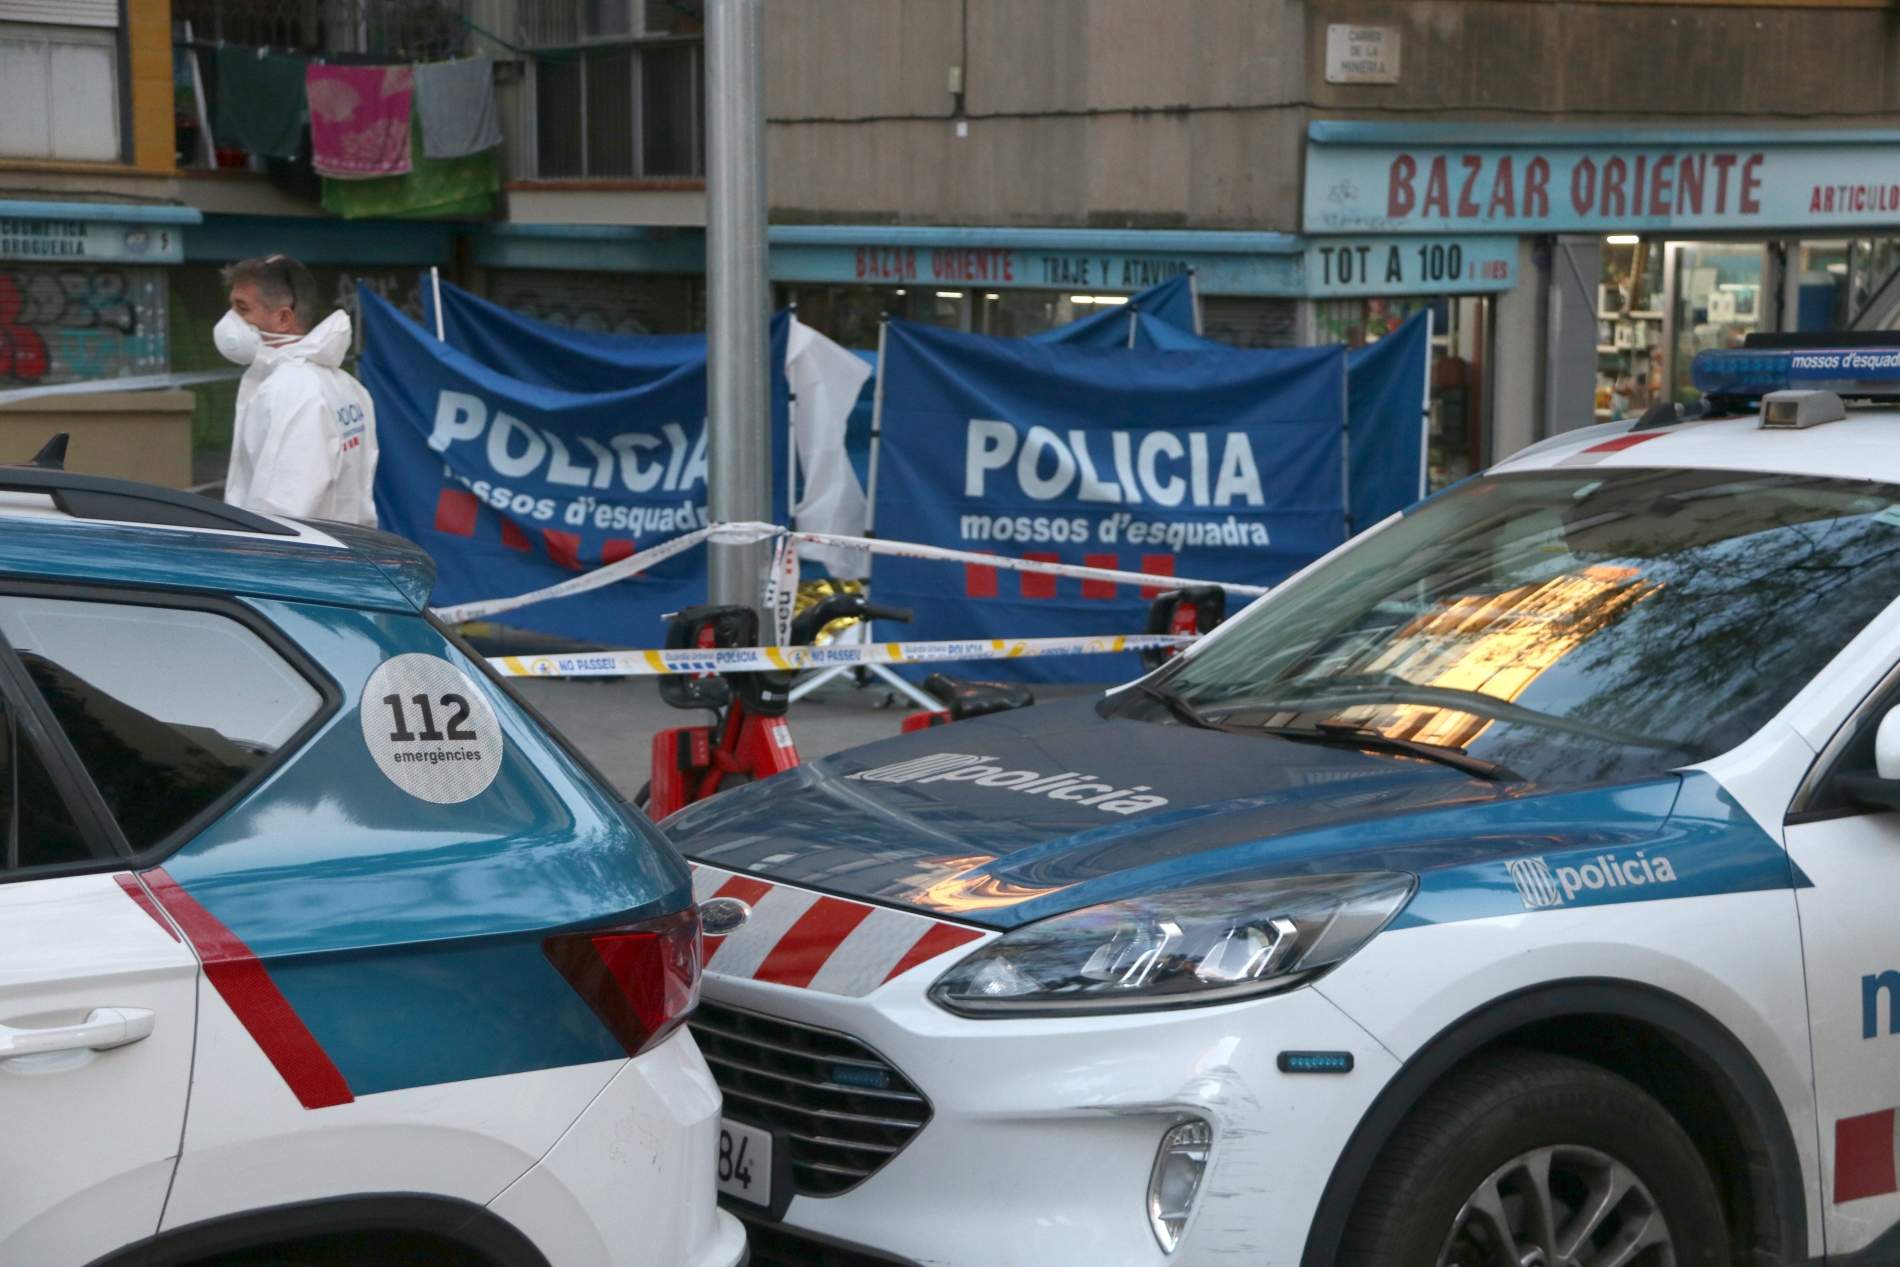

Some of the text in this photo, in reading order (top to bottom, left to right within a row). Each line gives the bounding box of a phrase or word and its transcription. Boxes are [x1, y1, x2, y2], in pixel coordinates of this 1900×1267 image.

[1387, 153, 1550, 218] BAZAR
[1570, 152, 1765, 217] ORIENTE
[855, 247, 917, 279] BAZAR
[931, 248, 1014, 282] ORIENTE
[1041, 256, 1089, 285] TRAJE
[1101, 259, 1111, 285] Y
[1319, 246, 1371, 285] TOT
[1385, 245, 1403, 283] A
[1418, 243, 1463, 282] 100
[1792, 352, 1900, 371] mossos d'esquad
[964, 418, 1265, 507] POLICIA
[564, 496, 708, 539] d'esquadr
[960, 513, 1271, 552] mossos d'esquadra
[577, 657, 616, 670] PASSEU
[383, 693, 477, 742] 112
[394, 747, 482, 765] emergències
[917, 764, 1169, 815] policia
[1556, 851, 1677, 900] policia
